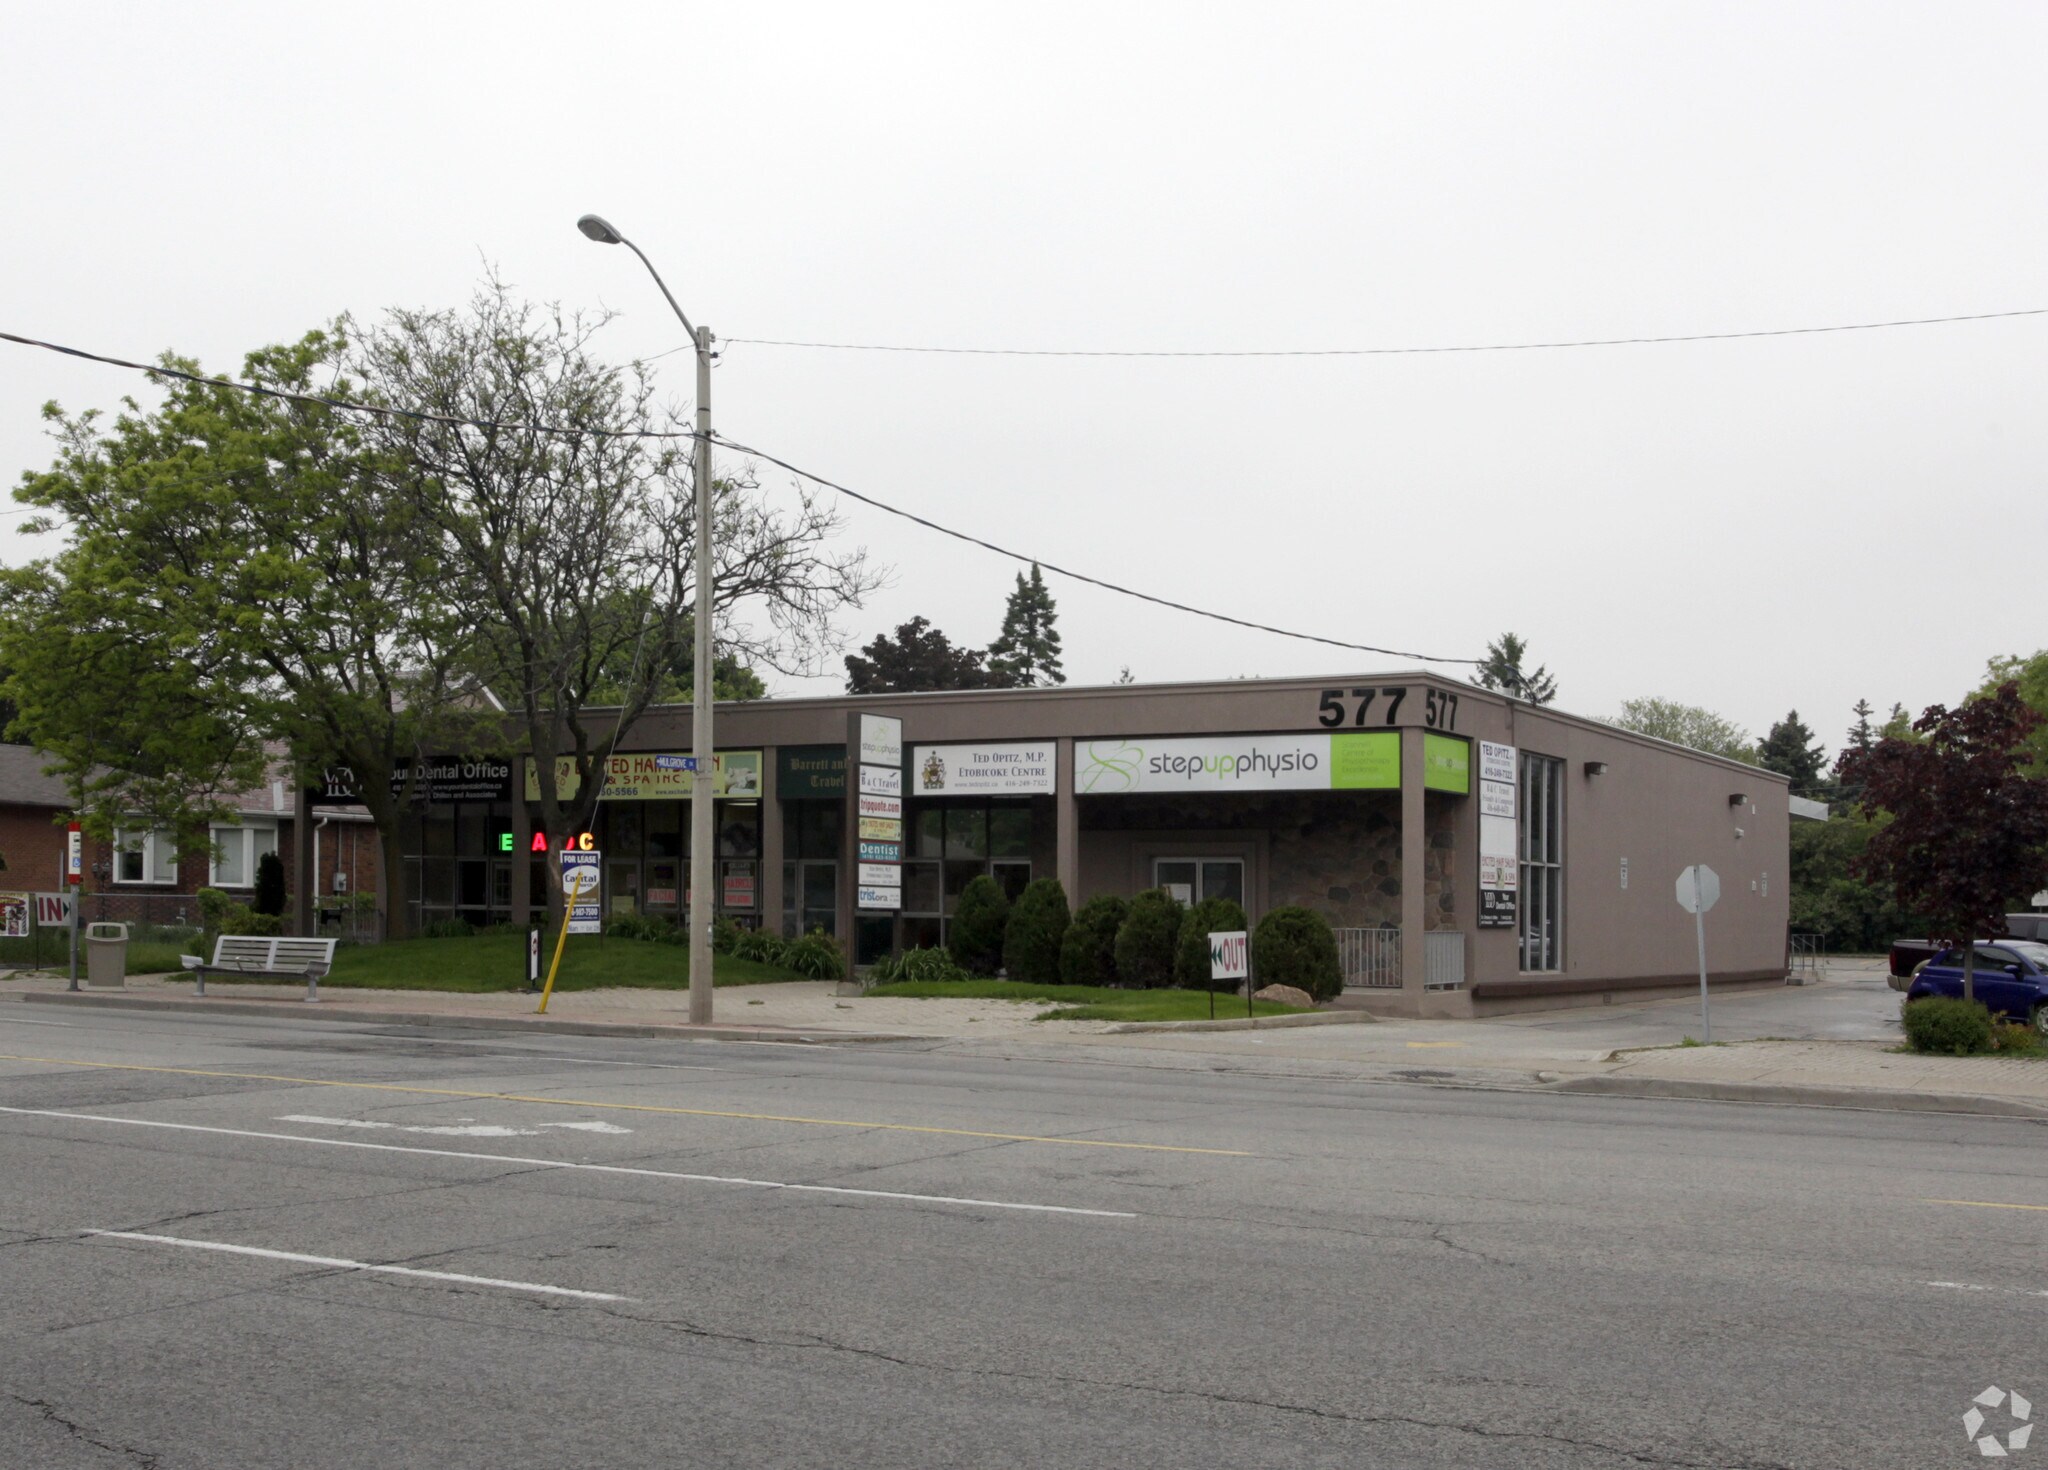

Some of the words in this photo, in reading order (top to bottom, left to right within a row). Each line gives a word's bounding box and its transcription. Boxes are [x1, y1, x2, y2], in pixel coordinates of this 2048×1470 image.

[1319, 687, 1406, 727] 577
[1425, 688, 1458, 730] 577
[1482, 744, 1493, 756] TED
[416, 765, 458, 779] Dental
[463, 761, 509, 778] Office
[623, 775, 650, 785] SPA
[657, 774, 685, 784] INC.
[860, 843, 898, 855] Dentist
[564, 855, 576, 863] FOR
[577, 855, 597, 863] LEASE
[38, 896, 63, 922] IN
[1223, 937, 1245, 971] OUT
